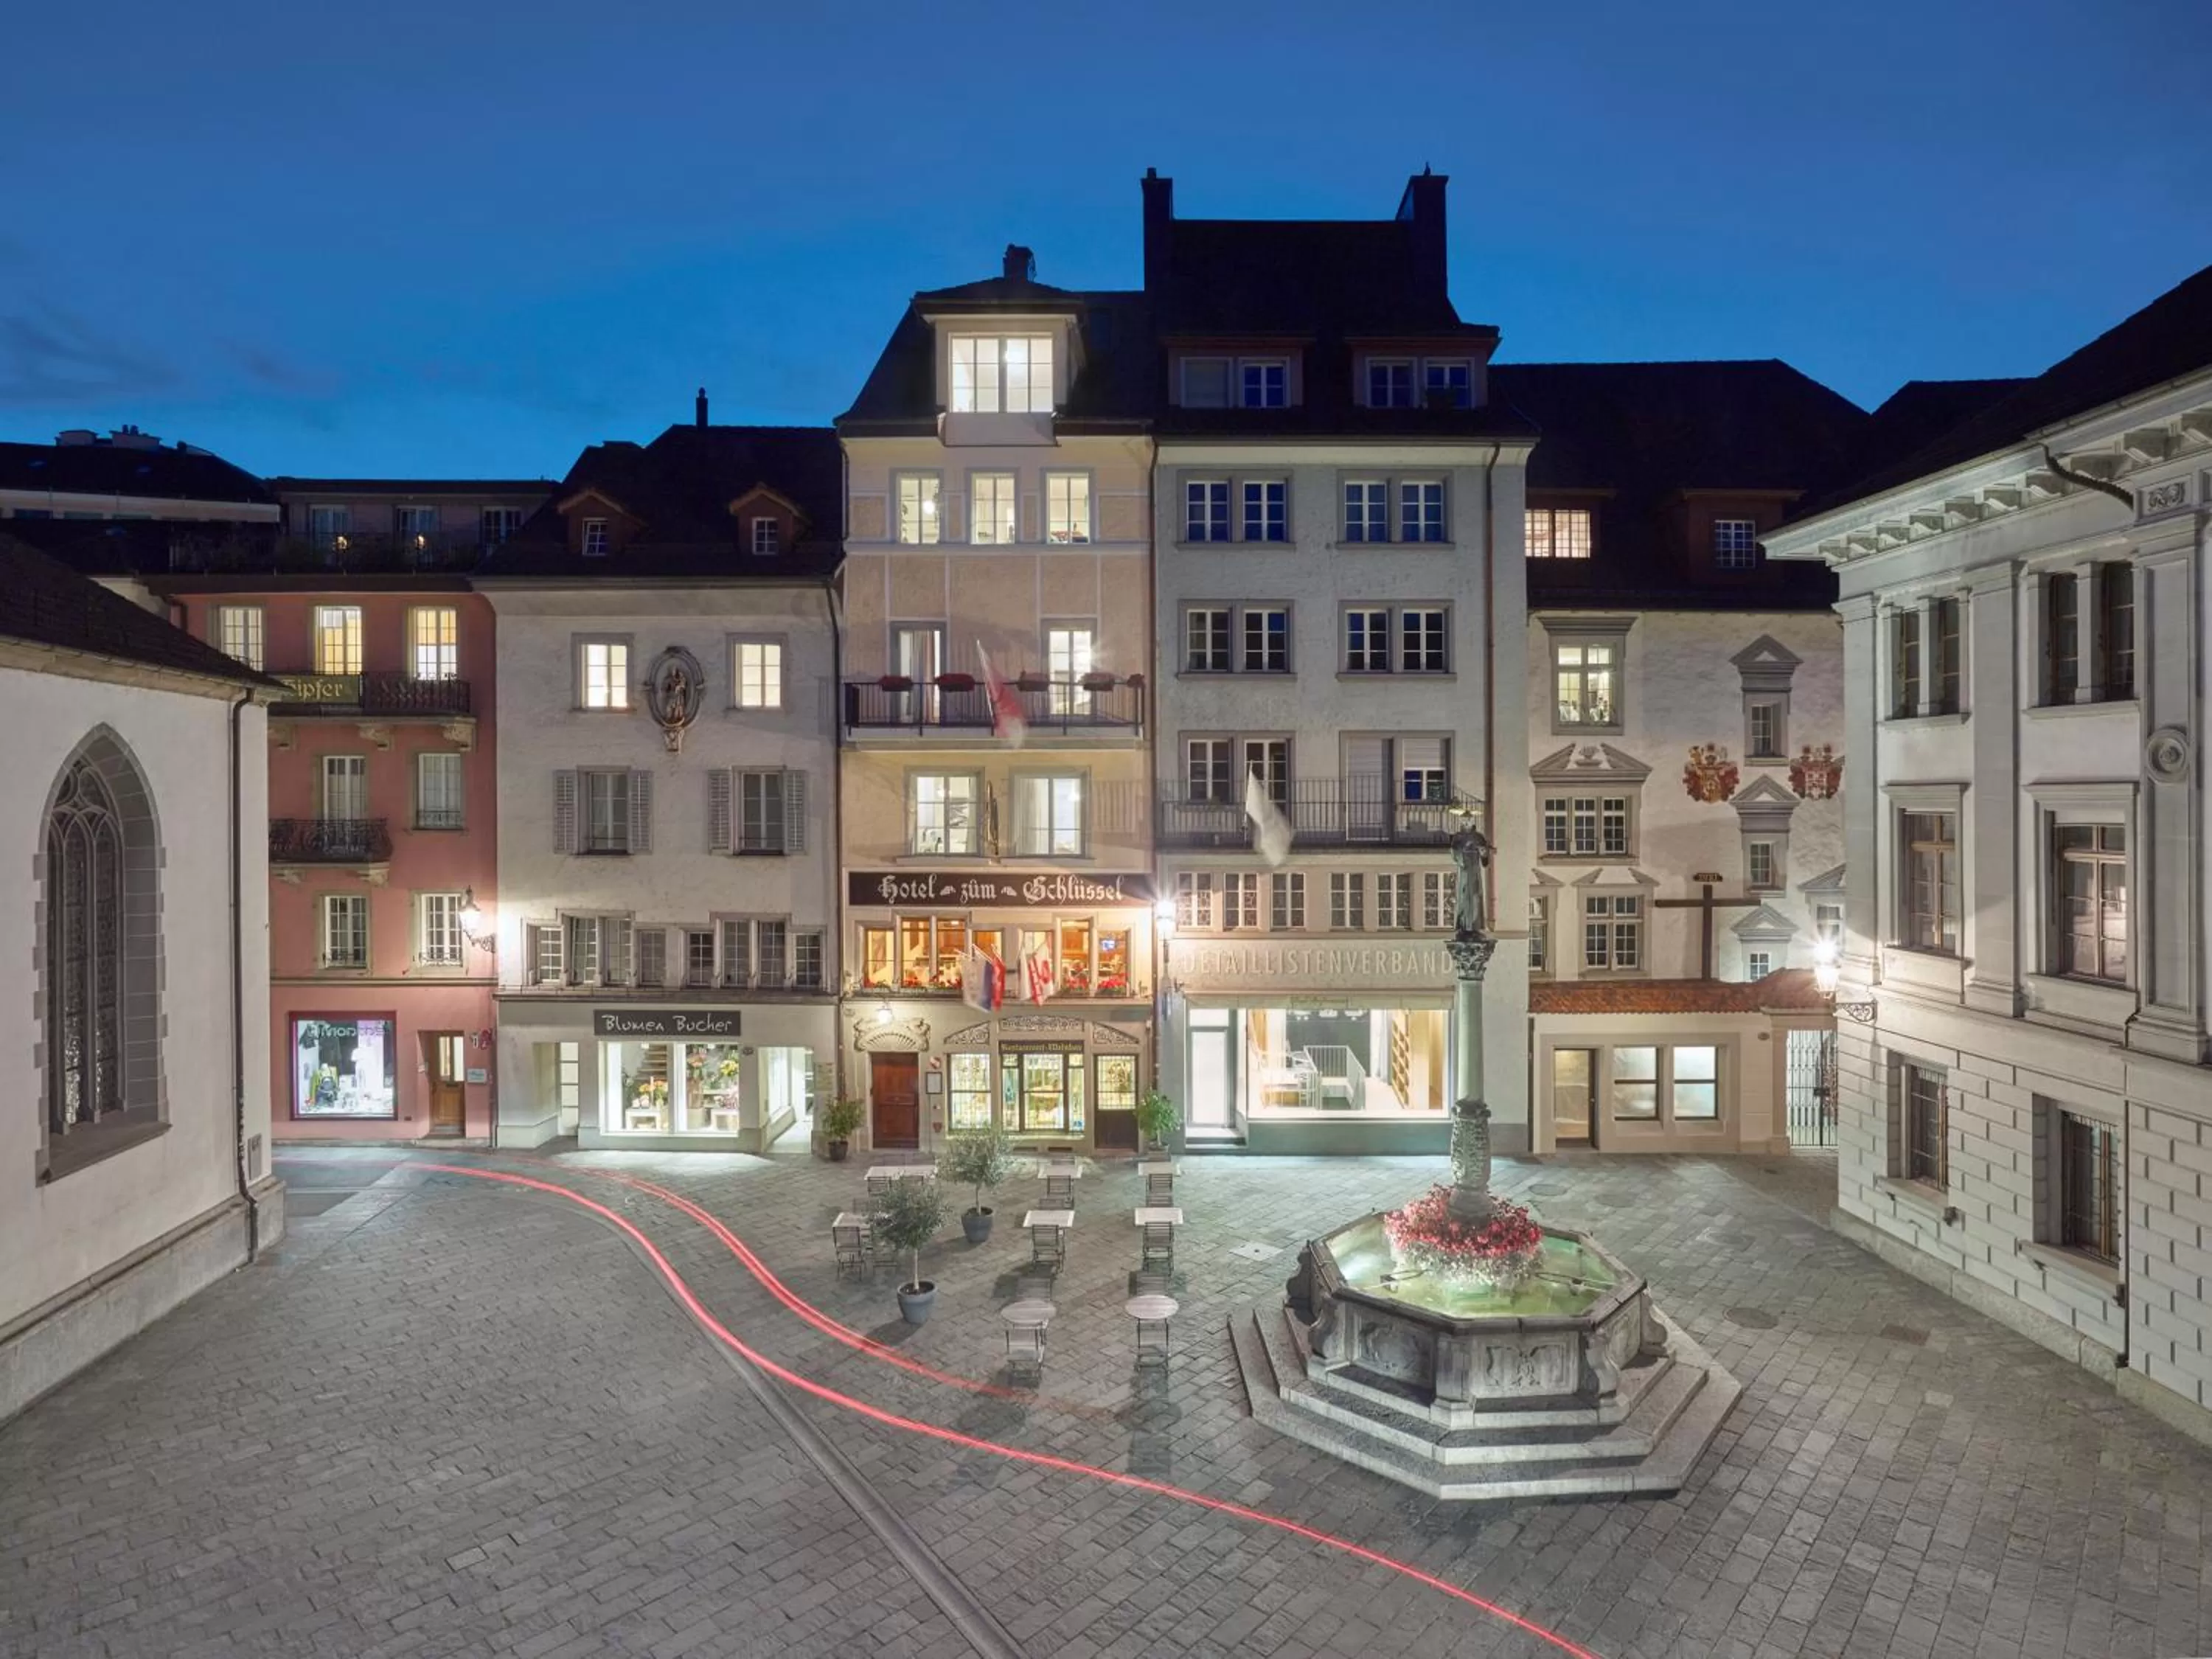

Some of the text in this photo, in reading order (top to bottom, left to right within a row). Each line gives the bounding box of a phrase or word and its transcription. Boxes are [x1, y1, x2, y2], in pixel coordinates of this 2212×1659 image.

[878, 874, 936, 905] Hotel
[1023, 874, 1125, 905] Schlüssel
[1183, 950, 1453, 975] DETAILLISTENVERBAND
[601, 1013, 732, 1032] Blumen Bucher
